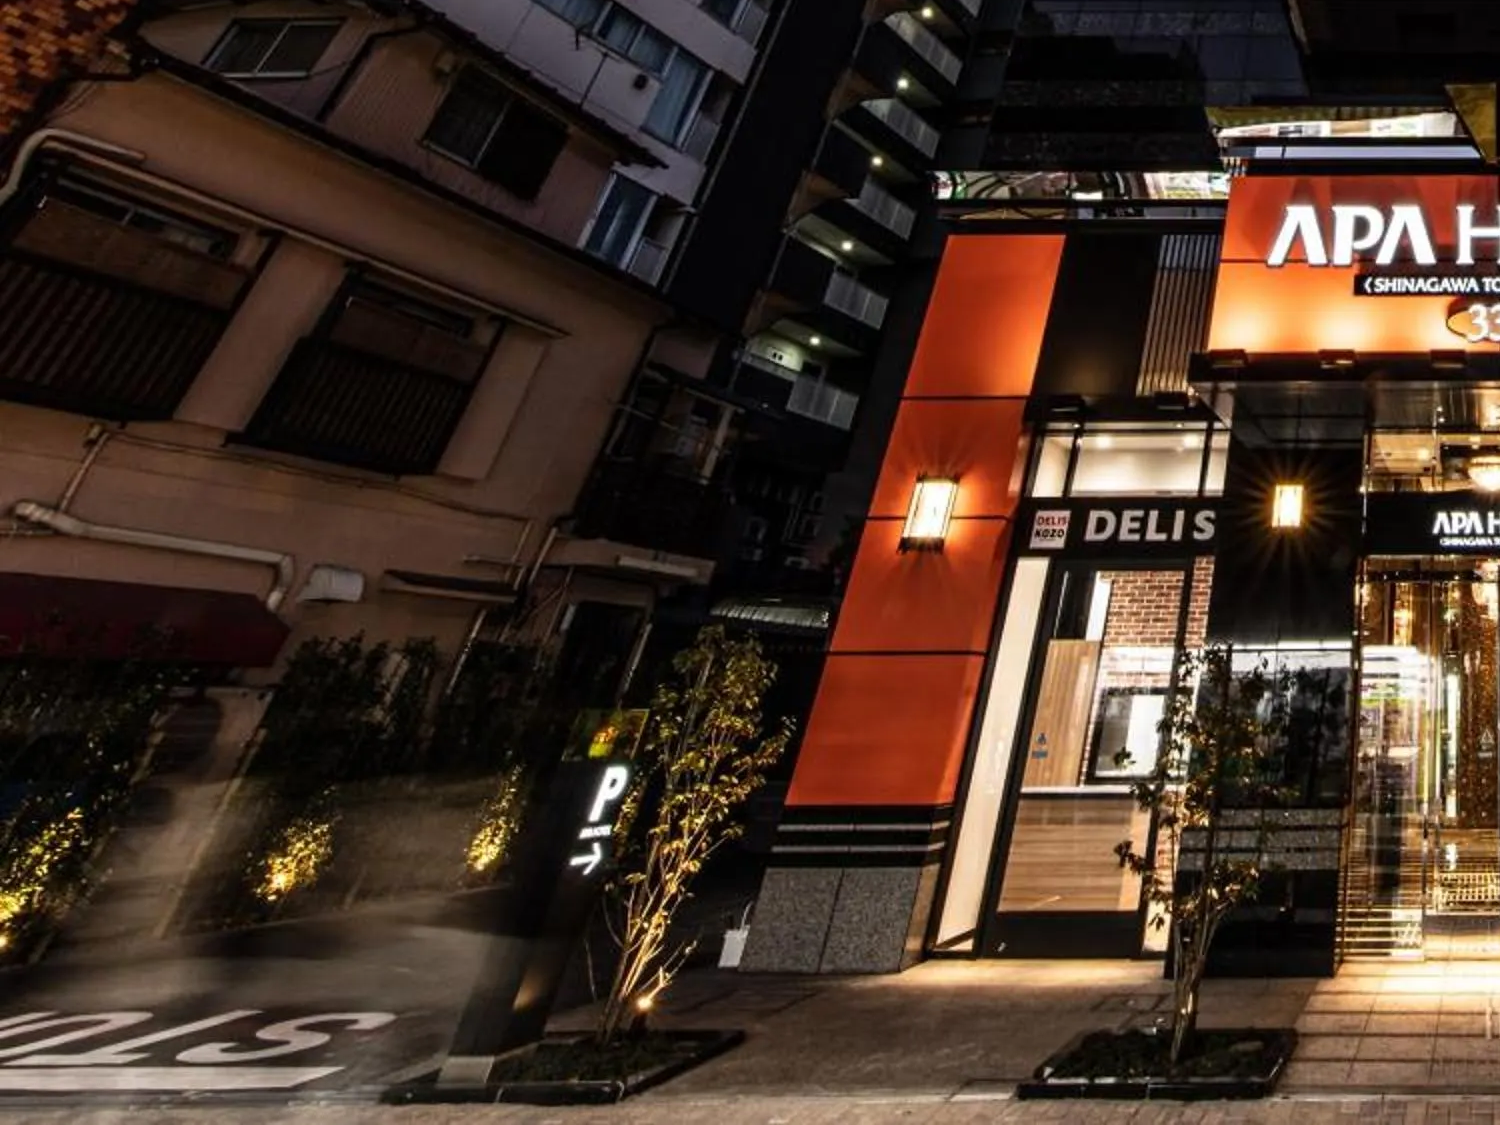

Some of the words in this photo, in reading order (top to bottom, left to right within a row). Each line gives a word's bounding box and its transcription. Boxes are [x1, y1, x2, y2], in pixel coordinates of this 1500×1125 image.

[1266, 203, 1437, 266] APA
[1037, 515, 1067, 526] DELIS
[1084, 509, 1217, 542] DELIS
[1432, 511, 1484, 534] APA
[588, 766, 628, 822] P
